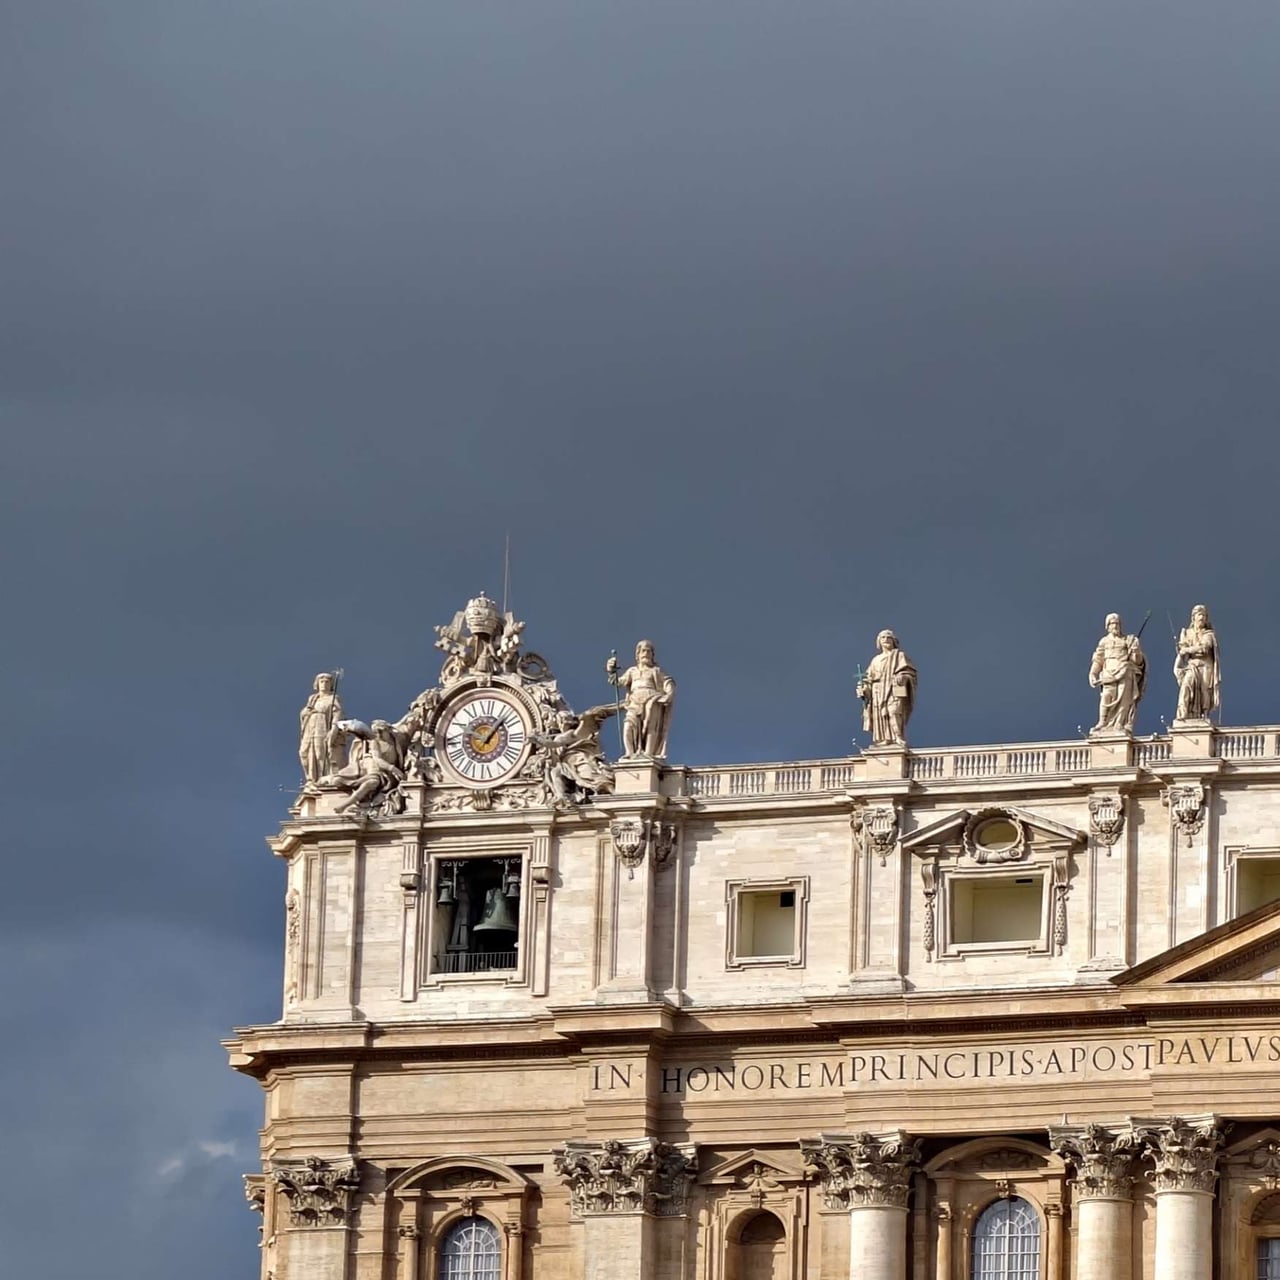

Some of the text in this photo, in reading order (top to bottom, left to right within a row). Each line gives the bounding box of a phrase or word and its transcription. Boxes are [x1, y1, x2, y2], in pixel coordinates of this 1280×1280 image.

[592, 1063, 632, 1091] IN
[660, 1061, 847, 1094] HONOREM
[849, 1049, 1035, 1083] PRINCIPIS
[1042, 1044, 1154, 1075] APOST
